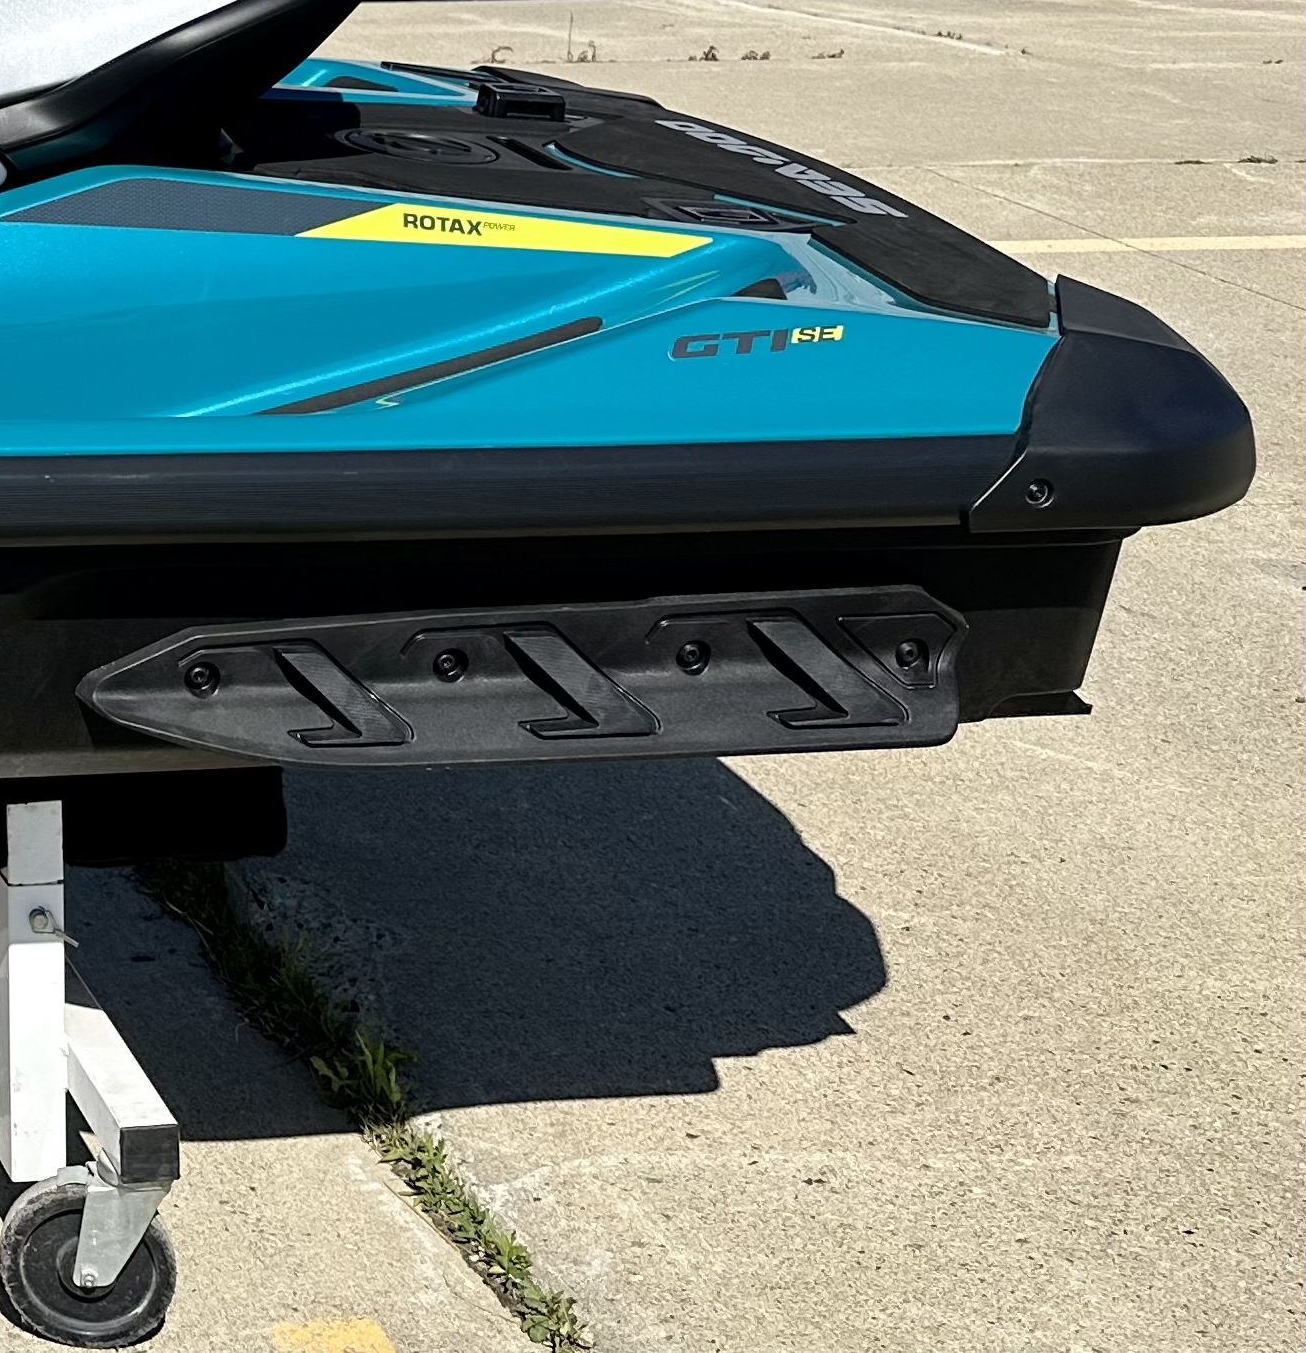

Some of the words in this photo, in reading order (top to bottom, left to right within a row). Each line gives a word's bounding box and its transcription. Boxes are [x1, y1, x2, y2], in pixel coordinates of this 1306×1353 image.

[403, 213, 483, 237] ROTAX
[671, 328, 789, 359] GTI
[797, 325, 843, 344] SE
